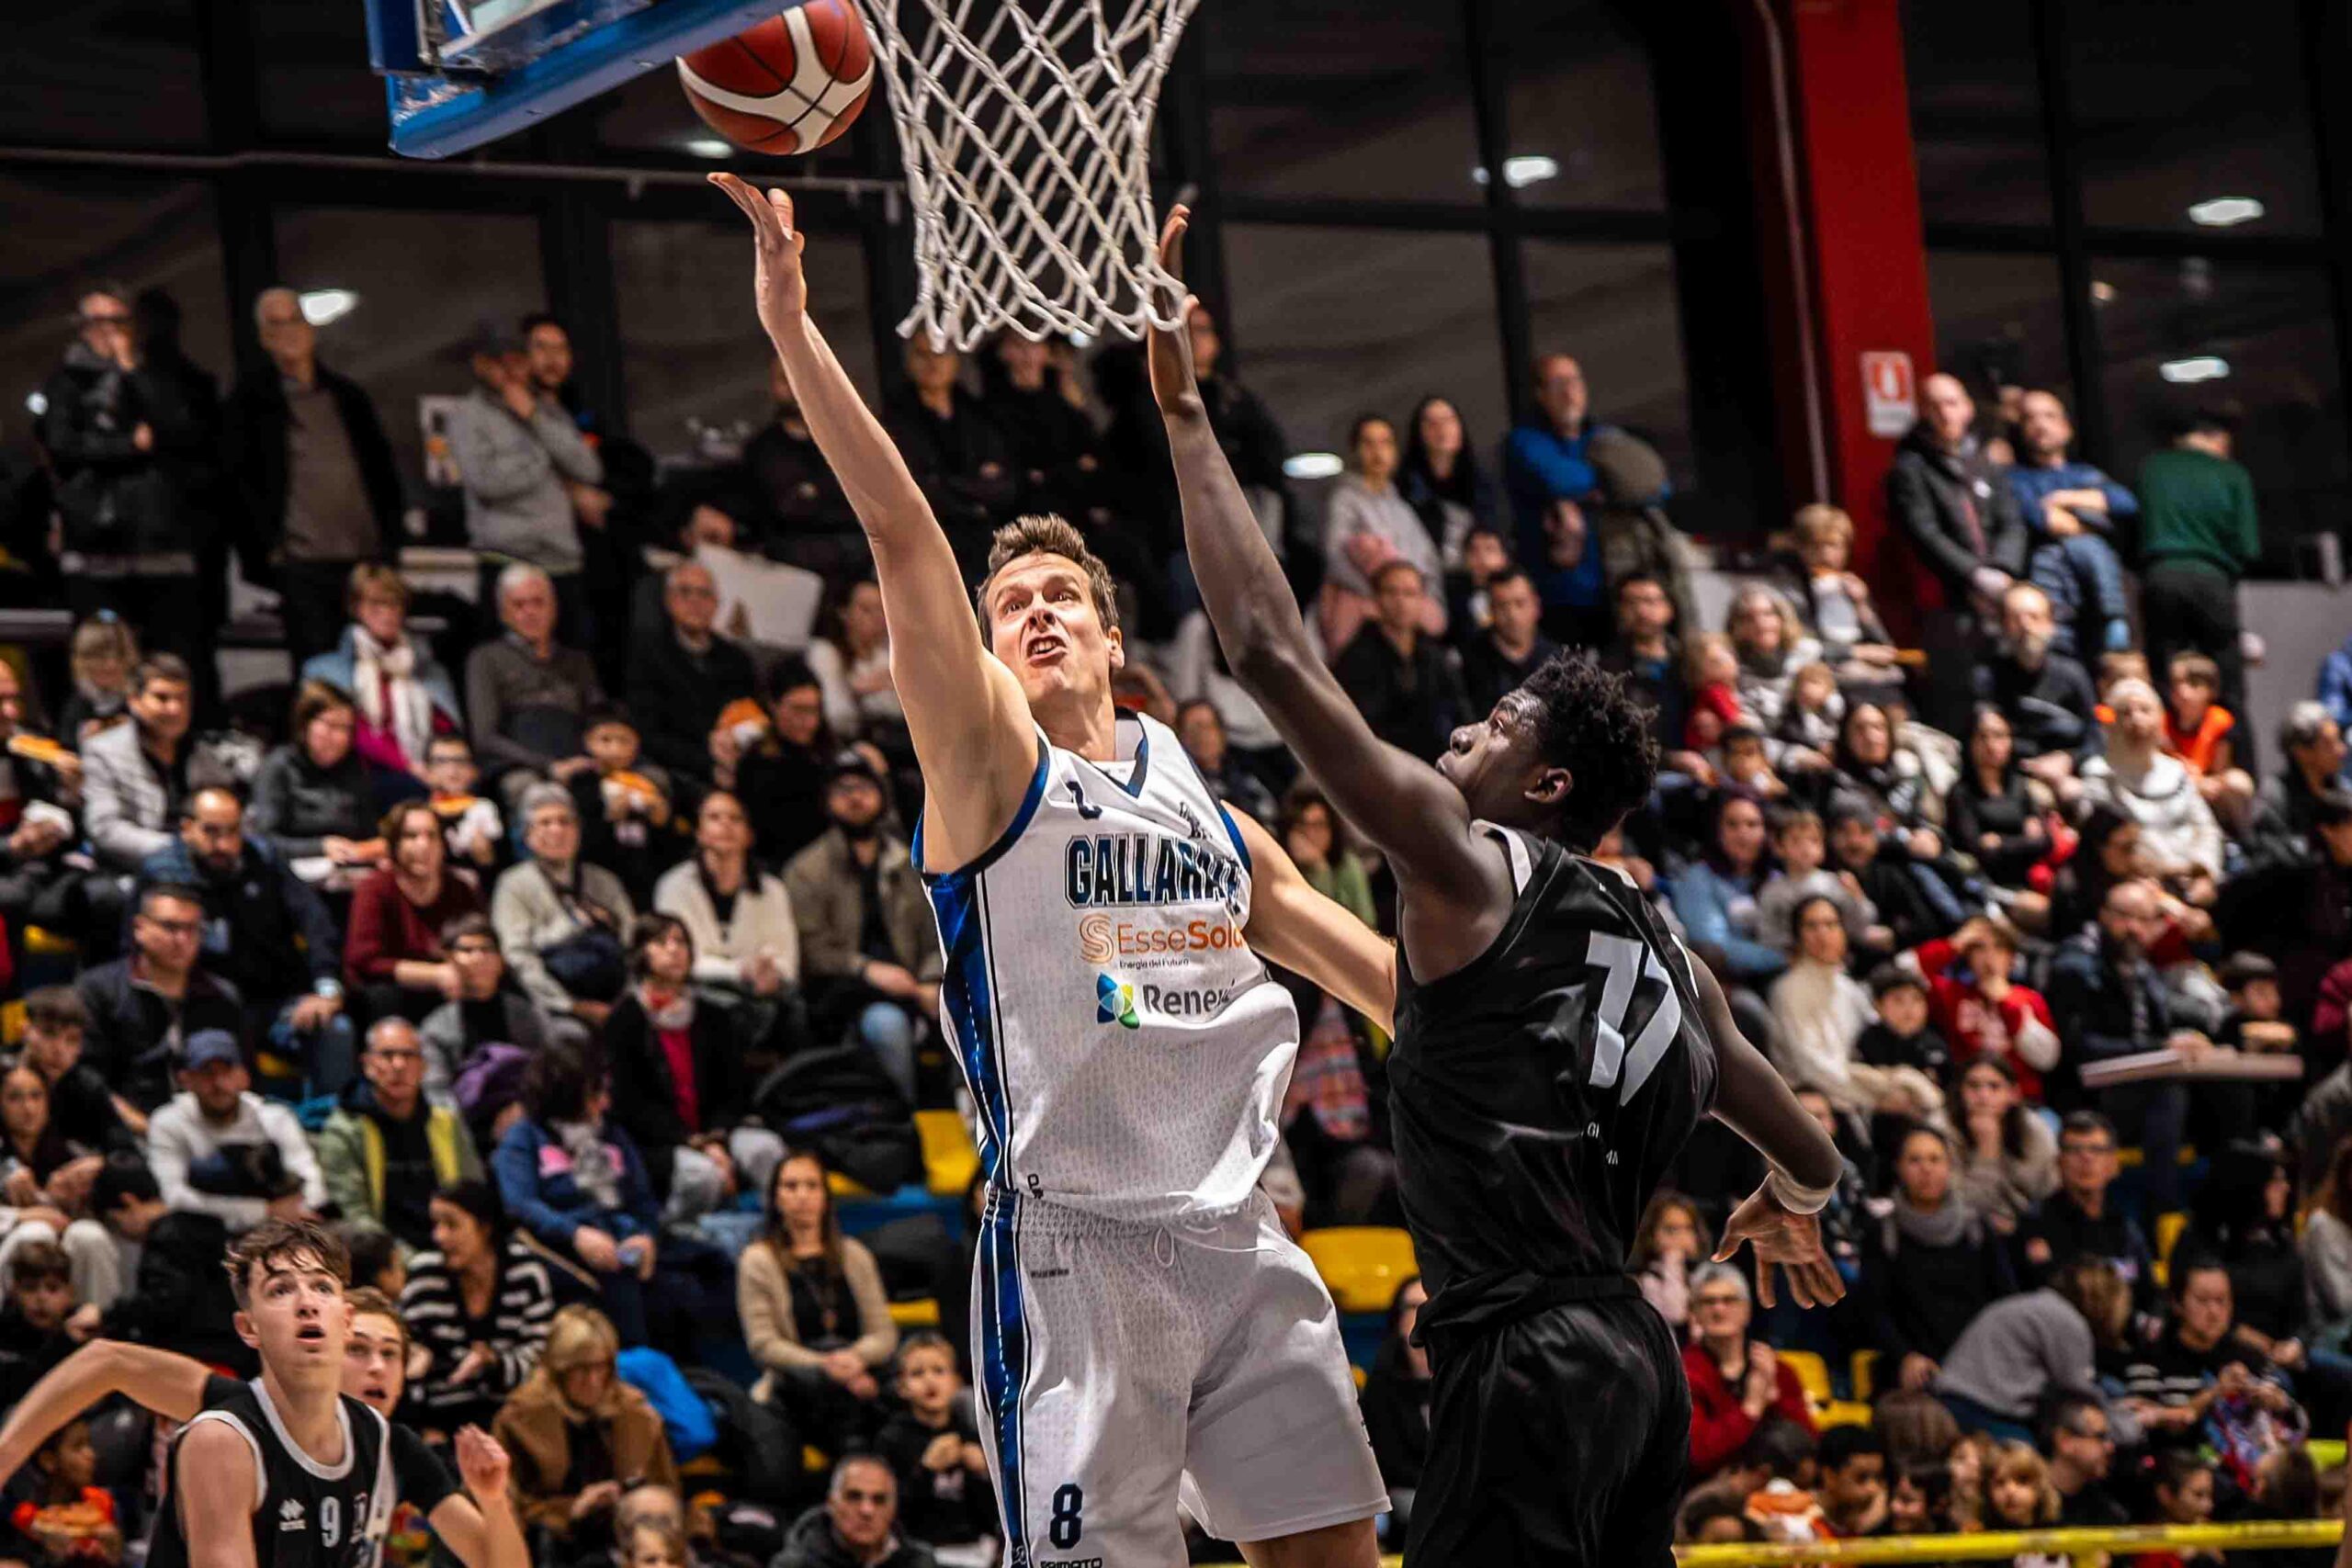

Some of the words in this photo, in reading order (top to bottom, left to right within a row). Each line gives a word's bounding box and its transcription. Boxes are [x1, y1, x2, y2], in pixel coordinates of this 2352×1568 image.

[1117, 920, 1242, 954] EsseSola
[320, 1495, 340, 1548] 9
[1049, 1483, 1082, 1551] 8
